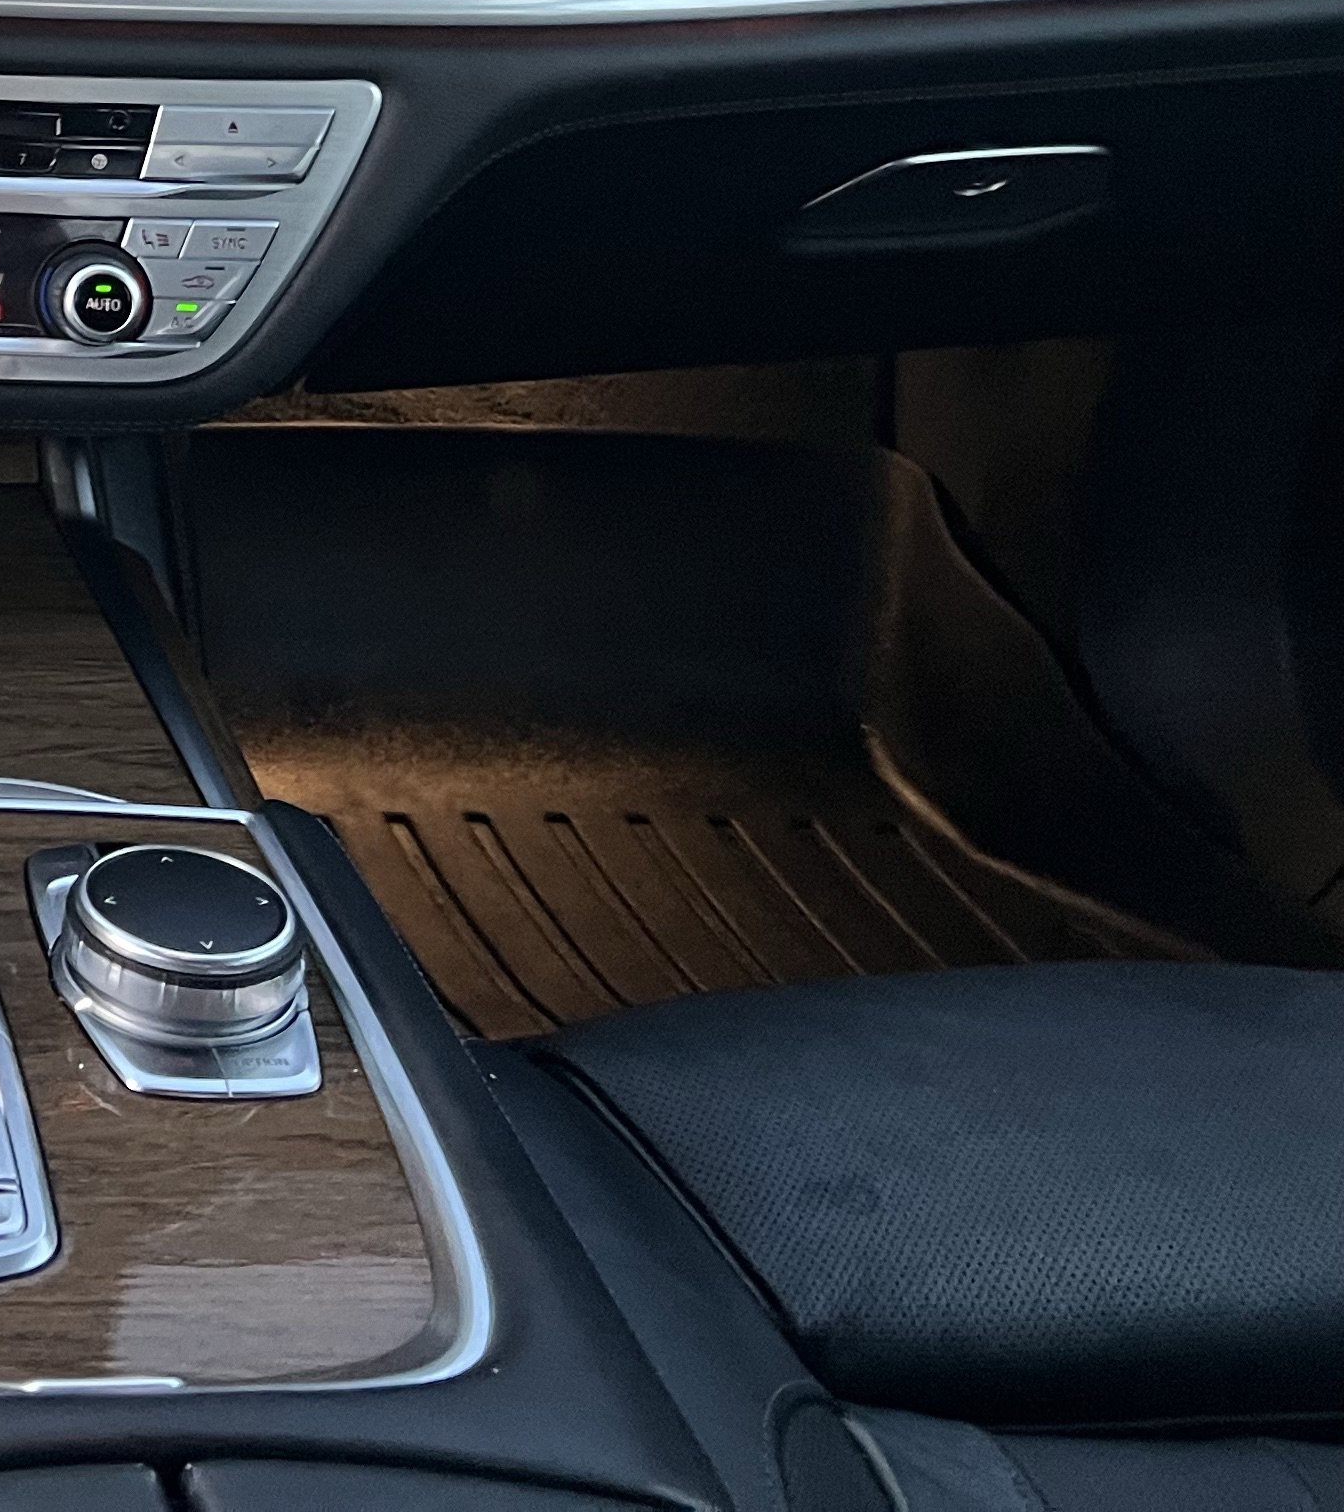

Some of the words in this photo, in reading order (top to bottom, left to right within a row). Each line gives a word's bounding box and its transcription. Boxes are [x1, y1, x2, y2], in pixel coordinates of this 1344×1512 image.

[18, 152, 28, 166] 7
[211, 237, 248, 250] SYNC
[85, 296, 121, 313] AUTO
